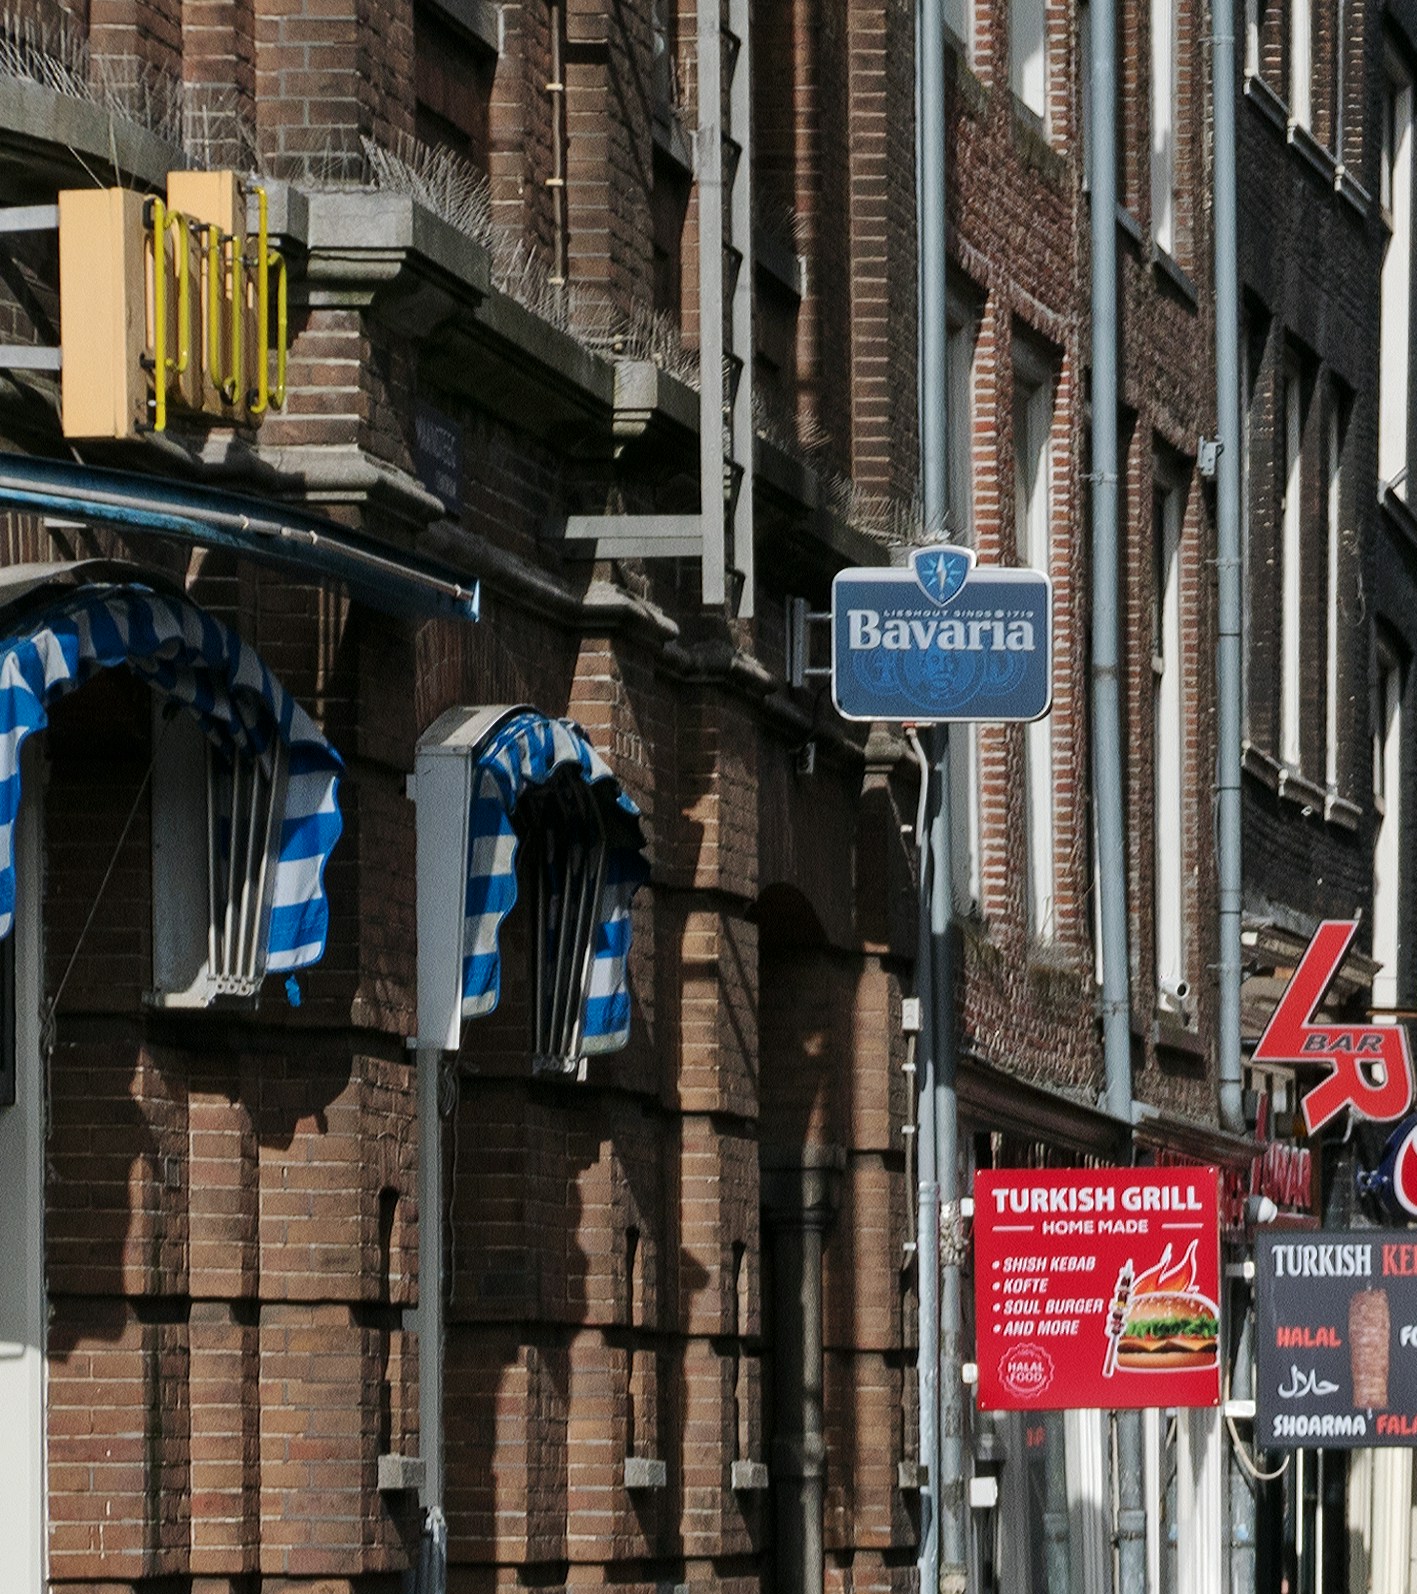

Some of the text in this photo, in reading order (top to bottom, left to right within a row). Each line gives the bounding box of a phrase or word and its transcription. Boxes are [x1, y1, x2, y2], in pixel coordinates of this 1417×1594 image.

[884, 609, 948, 618] LIESHOUT
[953, 609, 991, 618] SINDS
[847, 609, 1035, 650] Bavaria
[1301, 1033, 1384, 1053] BAR
[991, 1186, 1203, 1213] TURKISH GRILL
[1042, 1219, 1149, 1235] HOME MADE
[1002, 1256, 1097, 1272] SHISH KEBAB
[1271, 1244, 1372, 1277] TURKISH
[1003, 1278, 1049, 1294] KOFTE
[1003, 1298, 1104, 1315] SOUL BURGER
[1003, 1320, 1080, 1337] AND MORE
[1275, 1326, 1342, 1349] HALAL
[1008, 1361, 1044, 1373] HALAL
[1010, 1372, 1043, 1383] FOOD
[1277, 1364, 1340, 1399] حلال
[1272, 1414, 1367, 1437] SHOARMA
